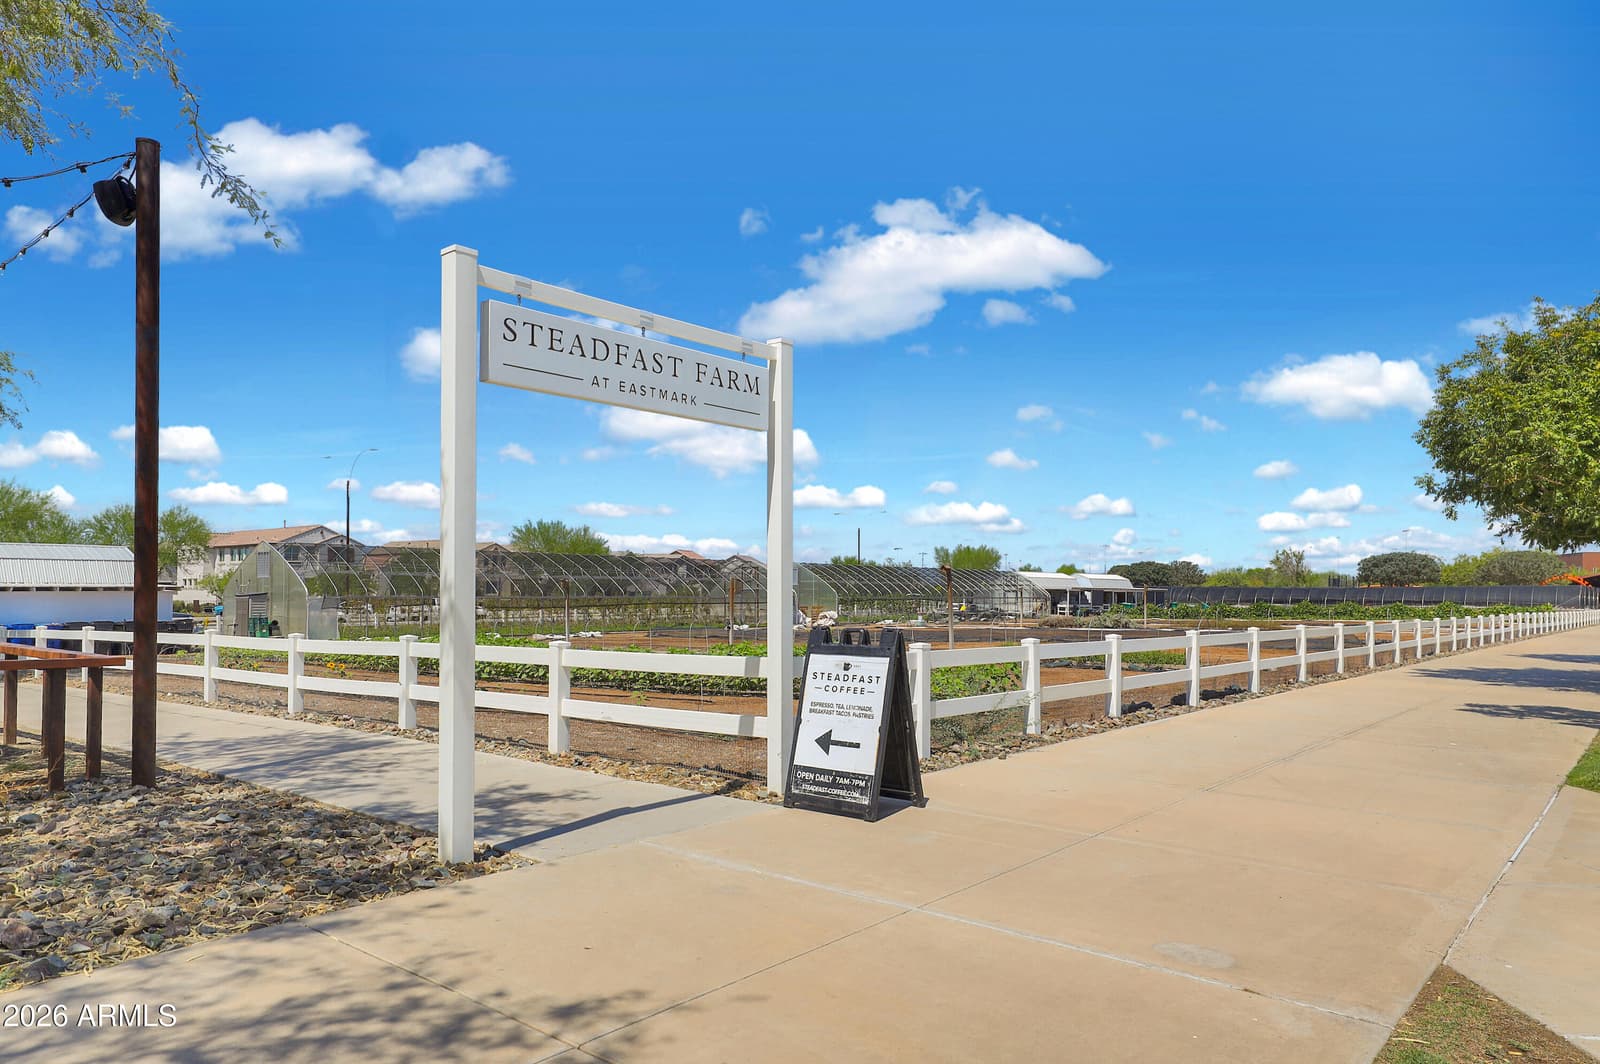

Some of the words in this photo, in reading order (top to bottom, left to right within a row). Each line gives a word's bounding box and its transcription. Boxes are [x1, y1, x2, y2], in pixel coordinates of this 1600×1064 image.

[503, 317, 683, 378] STEADFAST
[695, 362, 761, 396] FARM
[591, 375, 610, 389] AT
[619, 380, 698, 406] EASTMARK
[812, 671, 881, 685] STEADFAST
[824, 684, 866, 695] COFFEE
[852, 712, 875, 720] PASTRIES
[796, 771, 814, 780] OPEN
[815, 774, 833, 783] DAILY
[835, 776, 866, 787] 7AM-7PM
